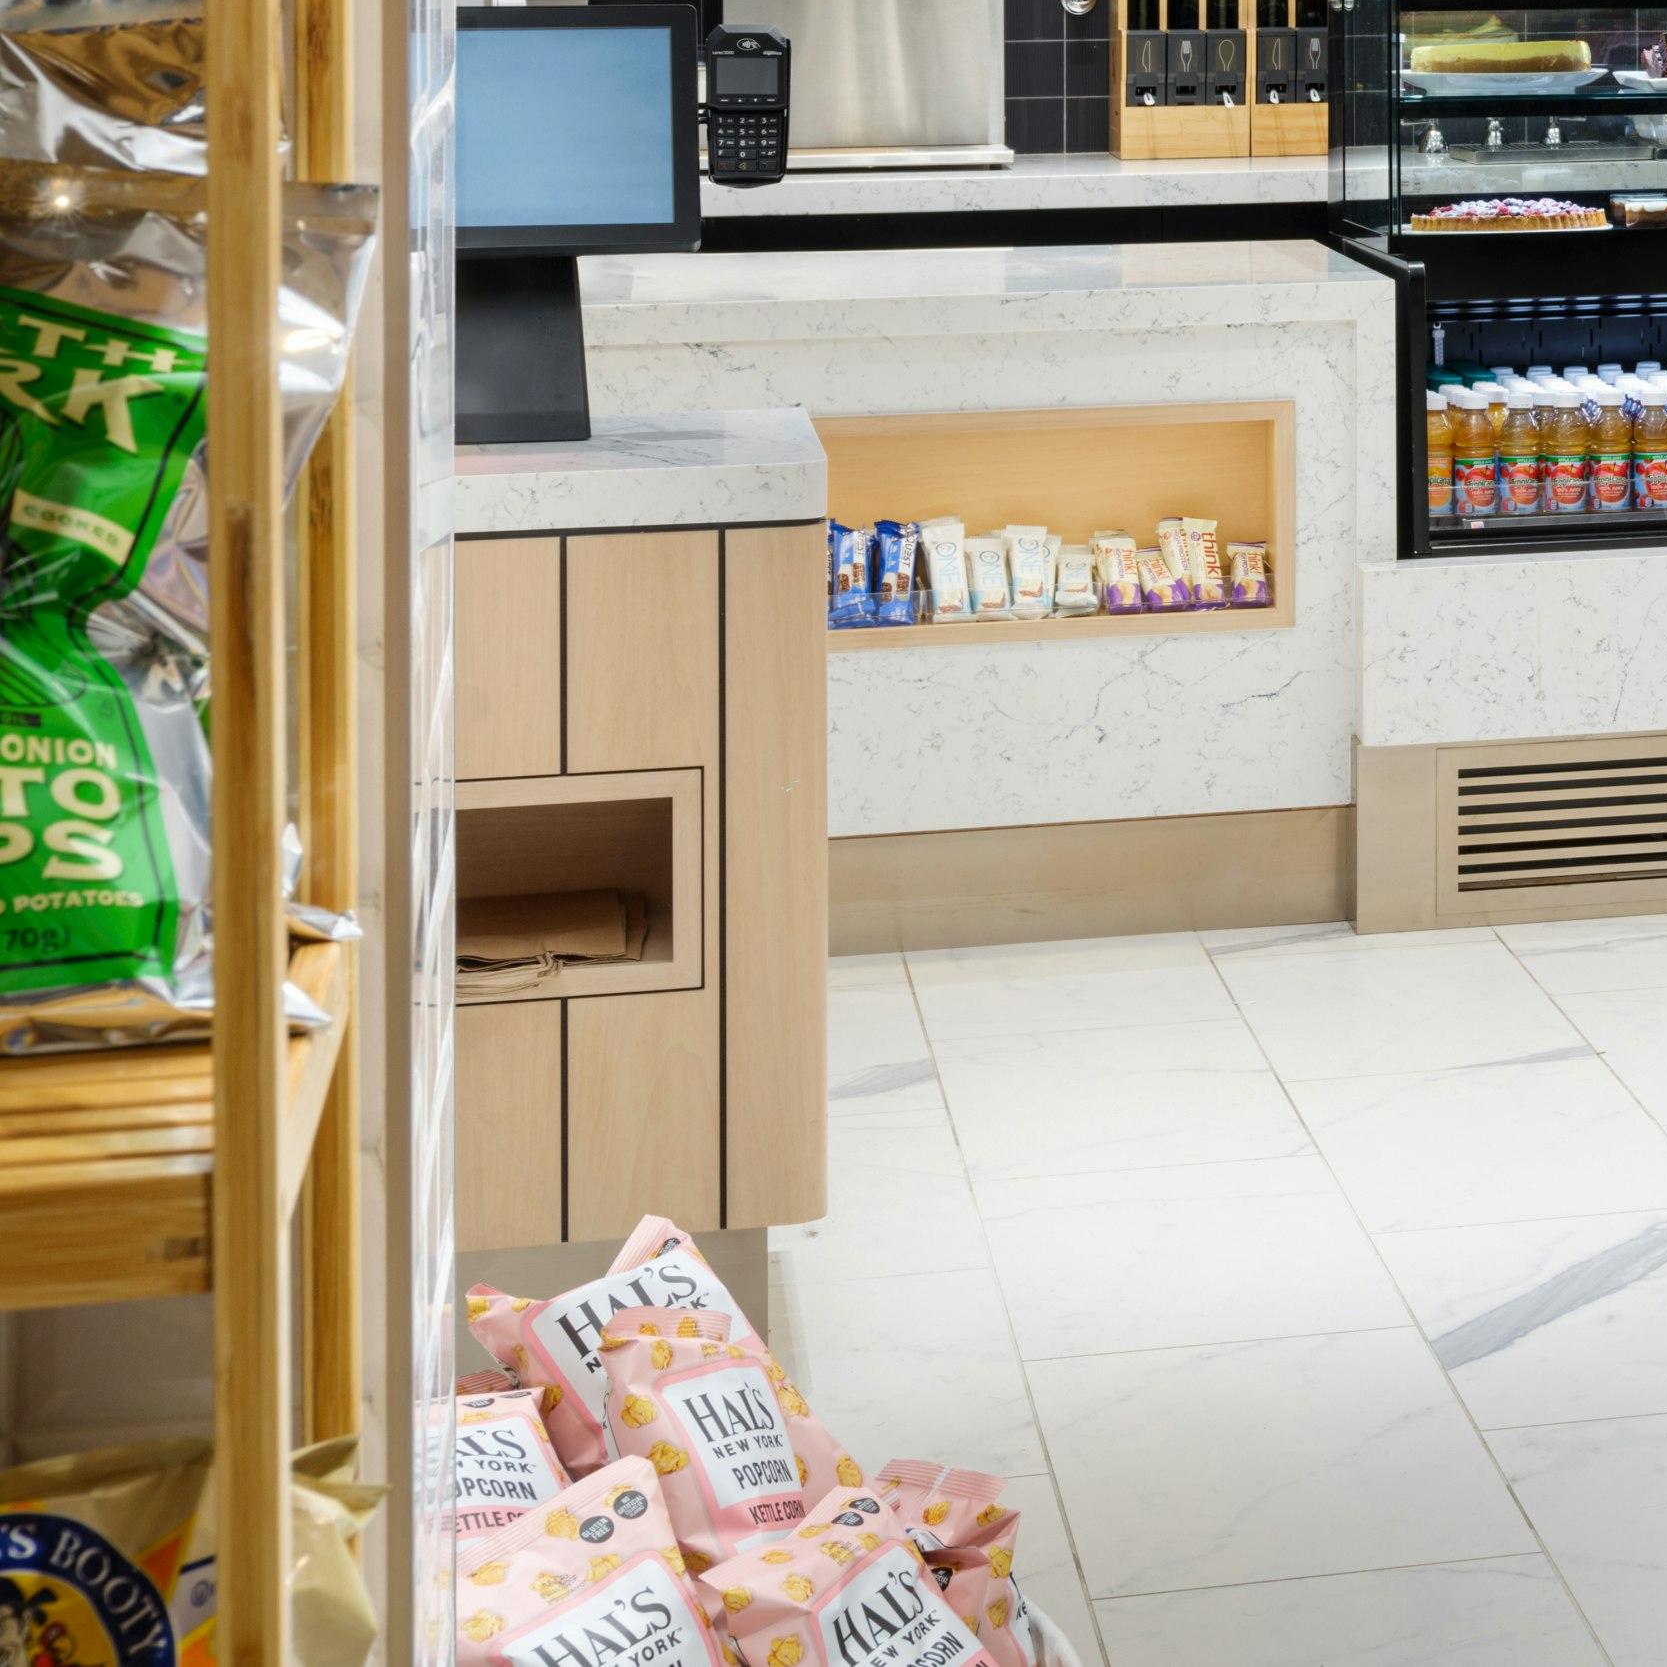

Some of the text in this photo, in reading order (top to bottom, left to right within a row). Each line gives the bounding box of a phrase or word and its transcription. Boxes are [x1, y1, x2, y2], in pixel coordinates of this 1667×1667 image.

[13, 888, 145, 914] POTATOES
[685, 1382, 775, 1442] HAL'S
[712, 1434, 783, 1459] NEW YORK
[732, 1458, 793, 1489] POPCORN
[748, 1503, 783, 1524] KETTLE
[902, 1611, 941, 1646] YORK
